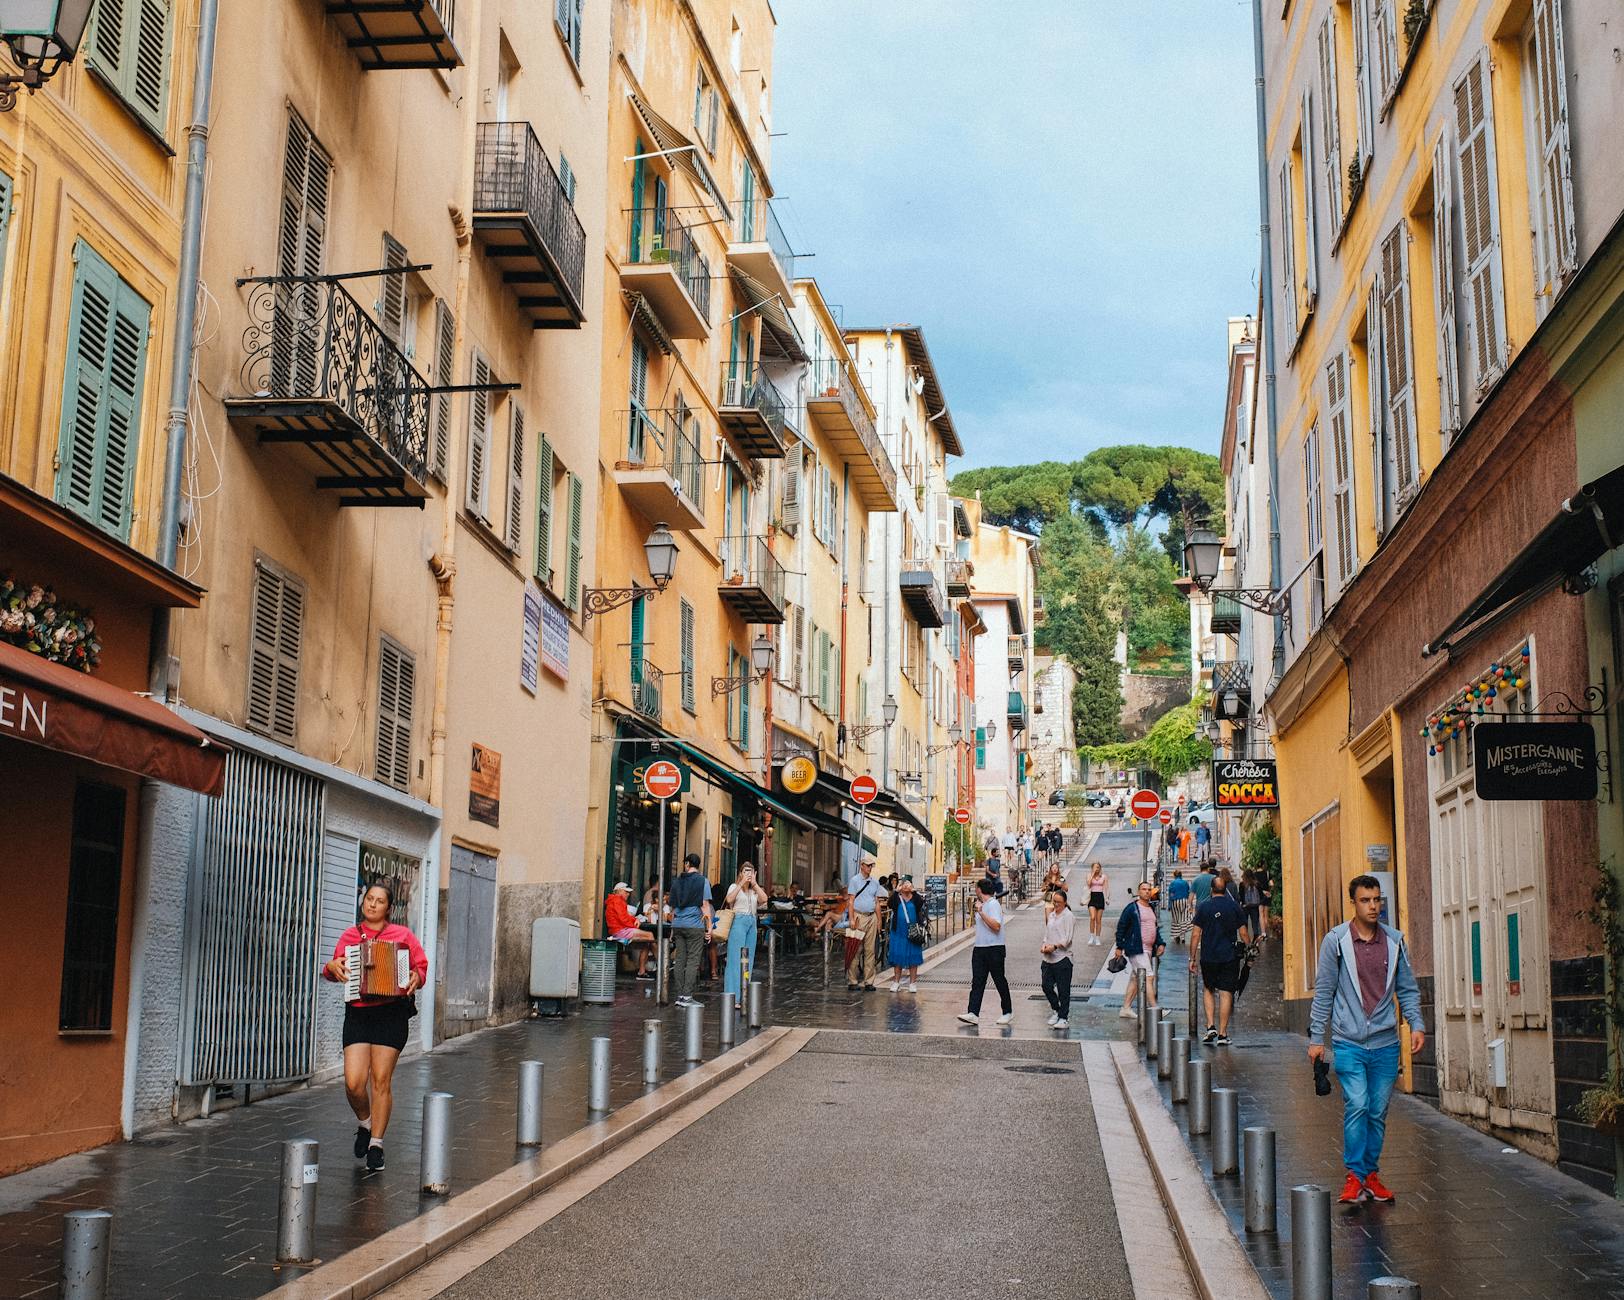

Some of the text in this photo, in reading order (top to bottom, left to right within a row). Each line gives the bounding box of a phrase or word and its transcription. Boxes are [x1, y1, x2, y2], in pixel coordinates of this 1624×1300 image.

[0, 686, 47, 738] EN
[791, 770, 807, 779] BEER
[1218, 783, 1277, 804] SOCCA
